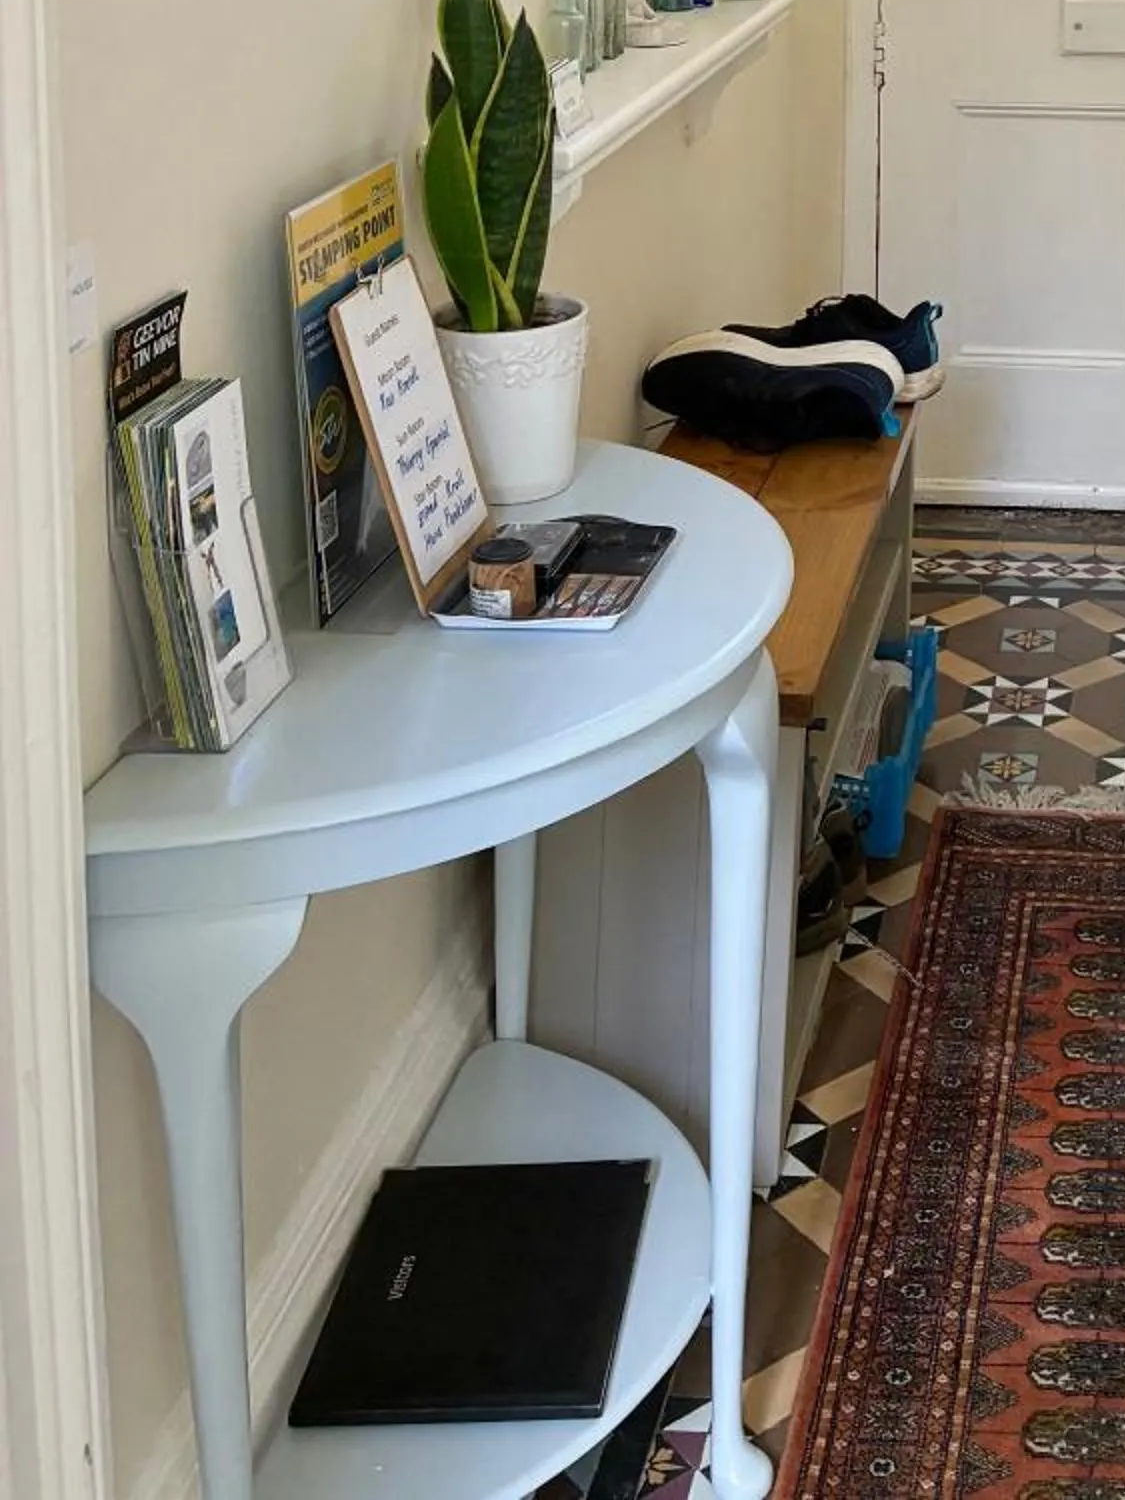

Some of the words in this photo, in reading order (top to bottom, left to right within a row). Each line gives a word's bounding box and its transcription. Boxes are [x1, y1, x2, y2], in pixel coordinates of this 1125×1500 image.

[362, 204, 395, 244] POINT
[133, 304, 180, 348] GEEVOR
[132, 343, 151, 371] TIN
[153, 327, 177, 359] MINE
